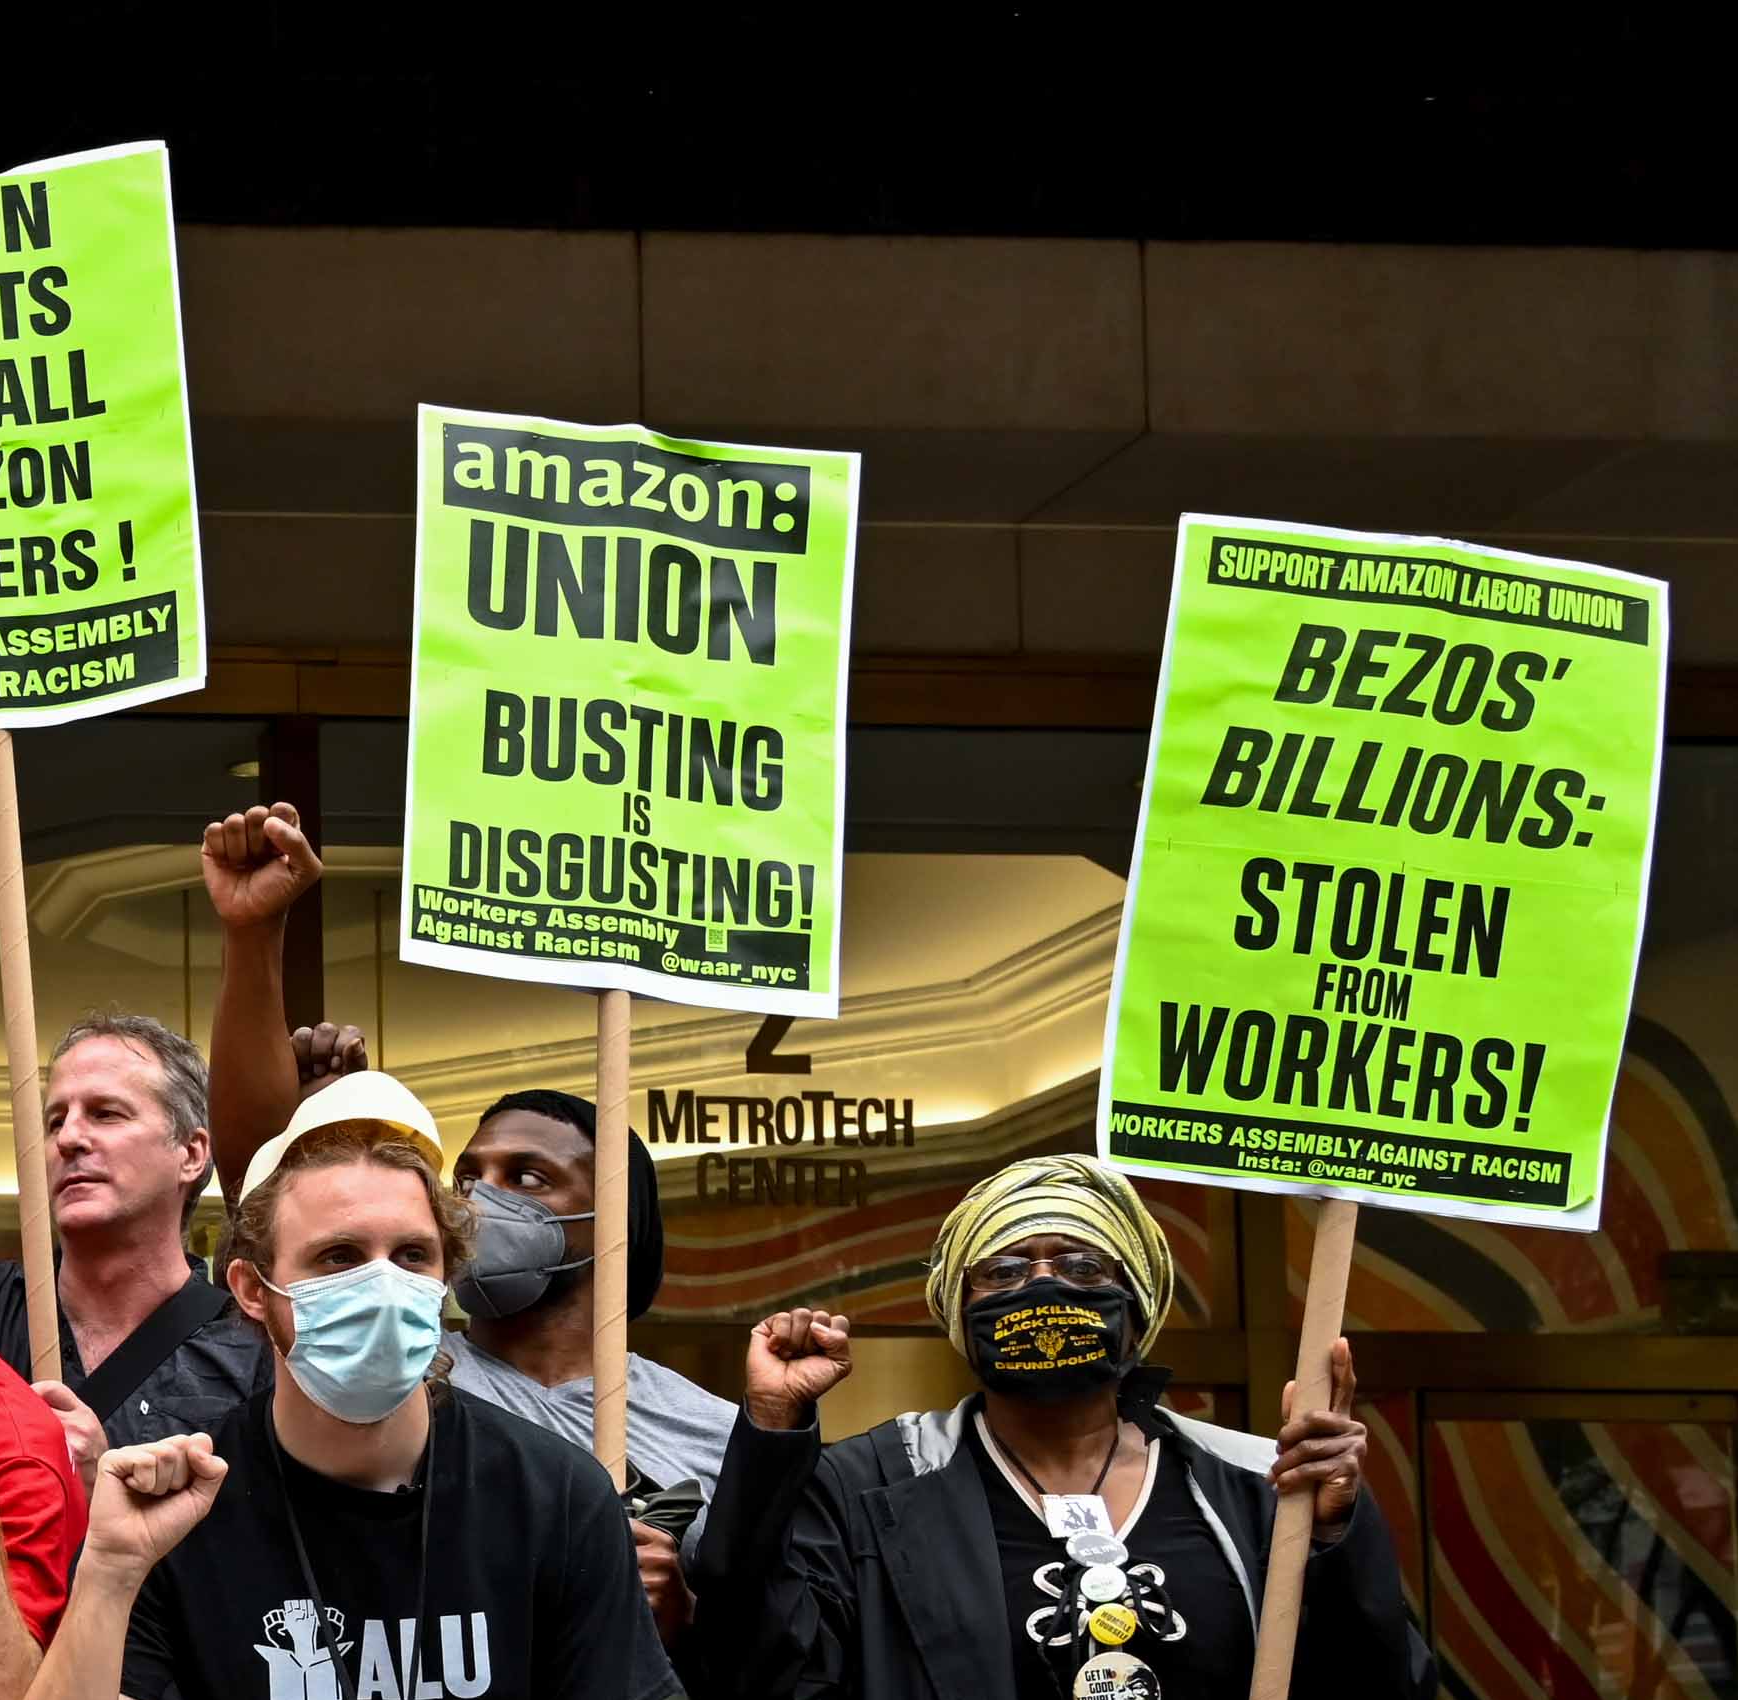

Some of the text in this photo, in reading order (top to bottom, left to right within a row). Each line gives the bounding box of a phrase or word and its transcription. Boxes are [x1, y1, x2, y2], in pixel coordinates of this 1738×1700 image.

[453, 439, 798, 534] amazon:
[467, 518, 778, 666] UNION
[1218, 545, 1624, 632] SUPPORT AMAZON LABOR UNION
[482, 688, 784, 812] BUSTING
[623, 792, 651, 837] IS
[1200, 726, 1607, 851] BILLIONS:
[448, 819, 816, 931] DISGUSTING!
[416, 916, 641, 963] Against Racism
[417, 889, 680, 950] Workers Assembly
[1233, 857, 1512, 979] STOLEN
[661, 952, 798, 985] @waar_nyc
[1313, 963, 1413, 1022] FROM
[1158, 1001, 1548, 1134] WORKERS!
[1110, 1110, 1563, 1185] WORKERS ASSEMBLY AGAINST RACISM
[1236, 1152, 1418, 1191] Insta: @waar_nyc
[994, 1316, 1107, 1340] BLACK PEOPLE
[995, 1305, 1102, 1329] STOP KILLING
[995, 1348, 1107, 1370] DEFUND POLICE
[1085, 1670, 1100, 1681] GET
[1089, 1681, 1114, 1694] GOOD
